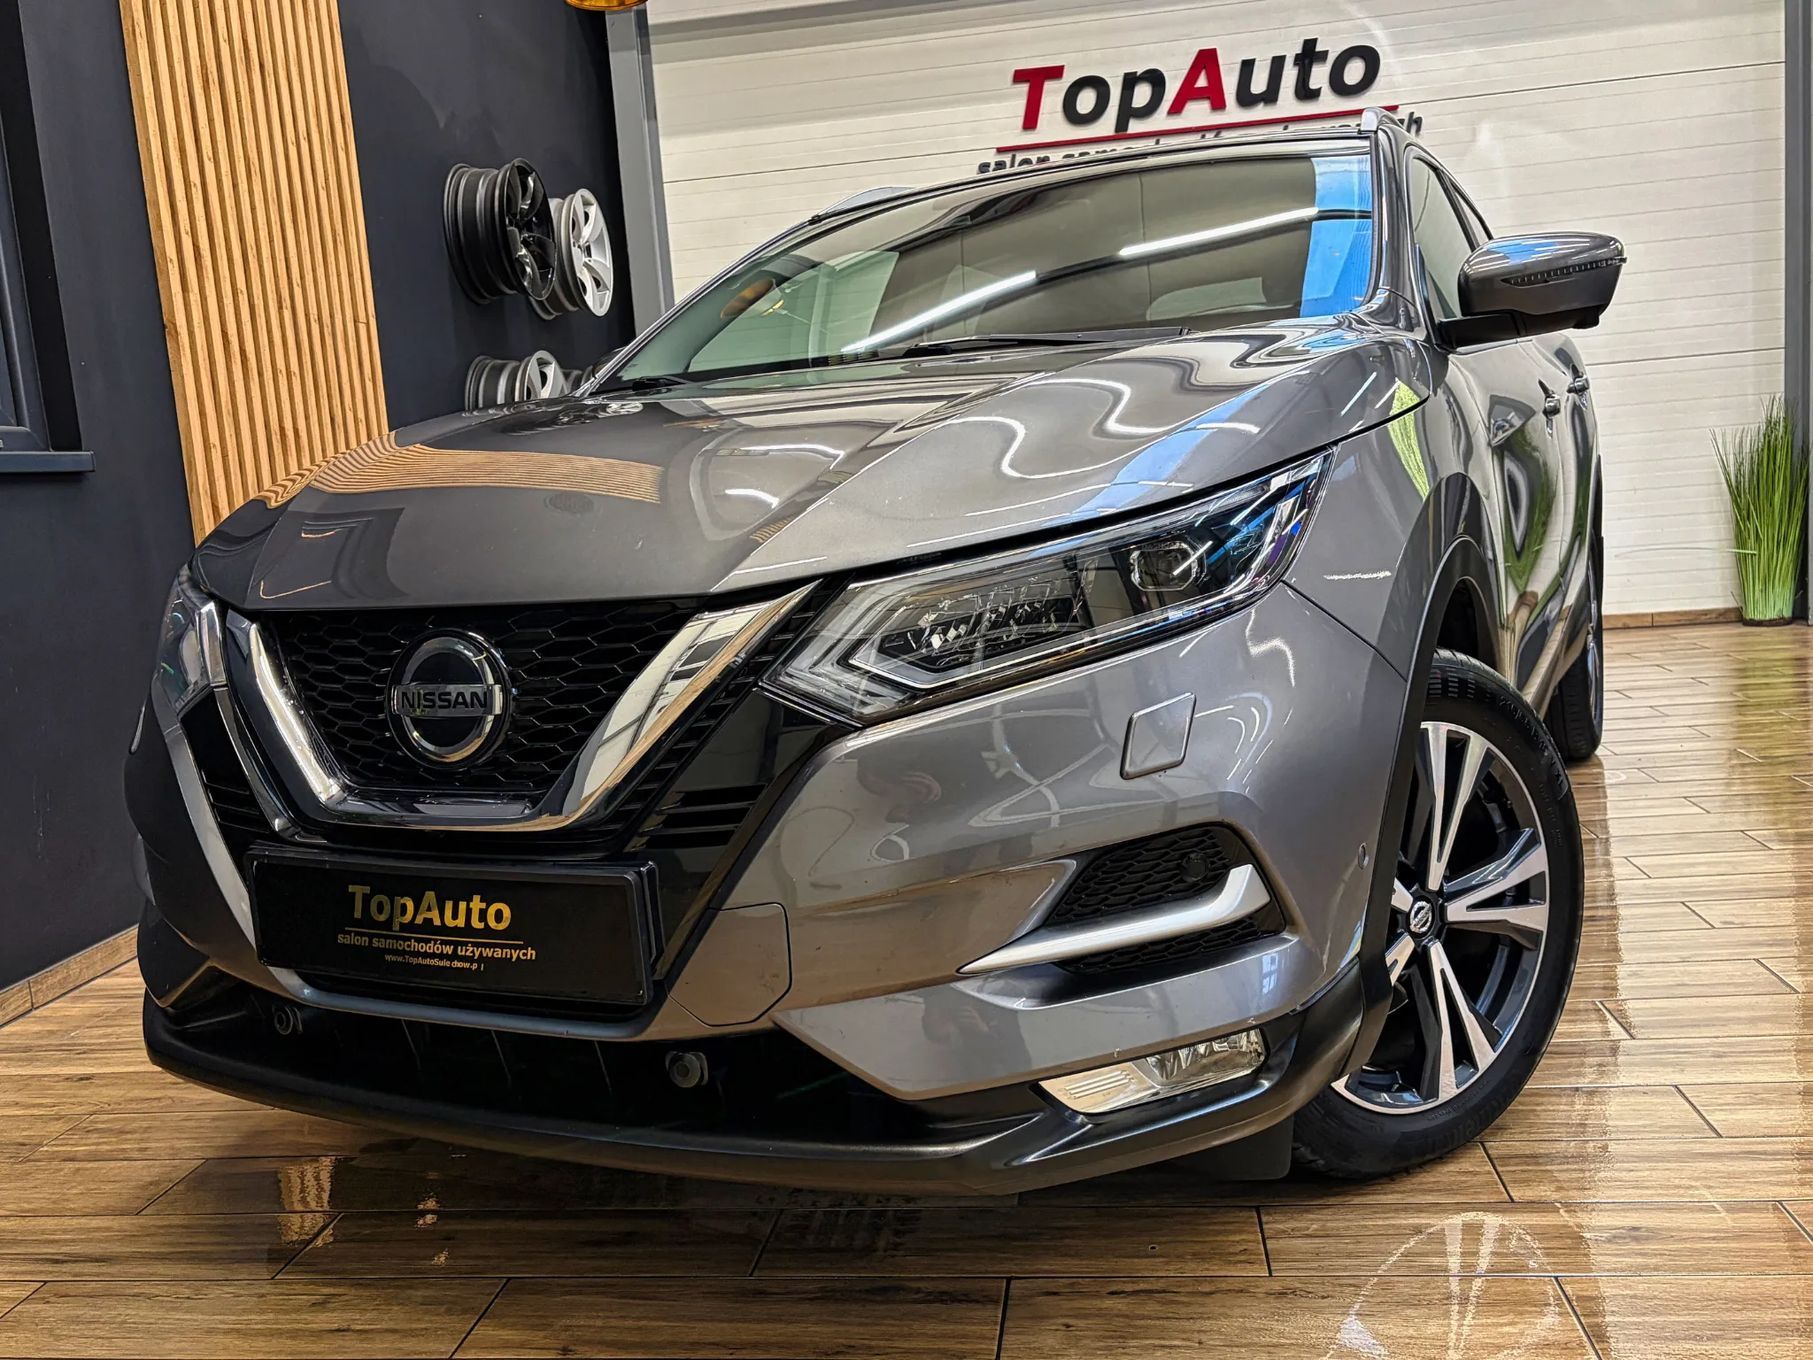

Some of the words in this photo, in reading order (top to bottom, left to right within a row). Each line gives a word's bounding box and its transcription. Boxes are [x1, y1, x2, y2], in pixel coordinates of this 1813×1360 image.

[1011, 37, 1383, 132] TopAuto
[401, 691, 488, 709] NISSAN
[348, 885, 512, 931] TopAuto
[337, 932, 369, 946] salon
[372, 938, 454, 955] samochodów
[457, 943, 536, 961] używanych
